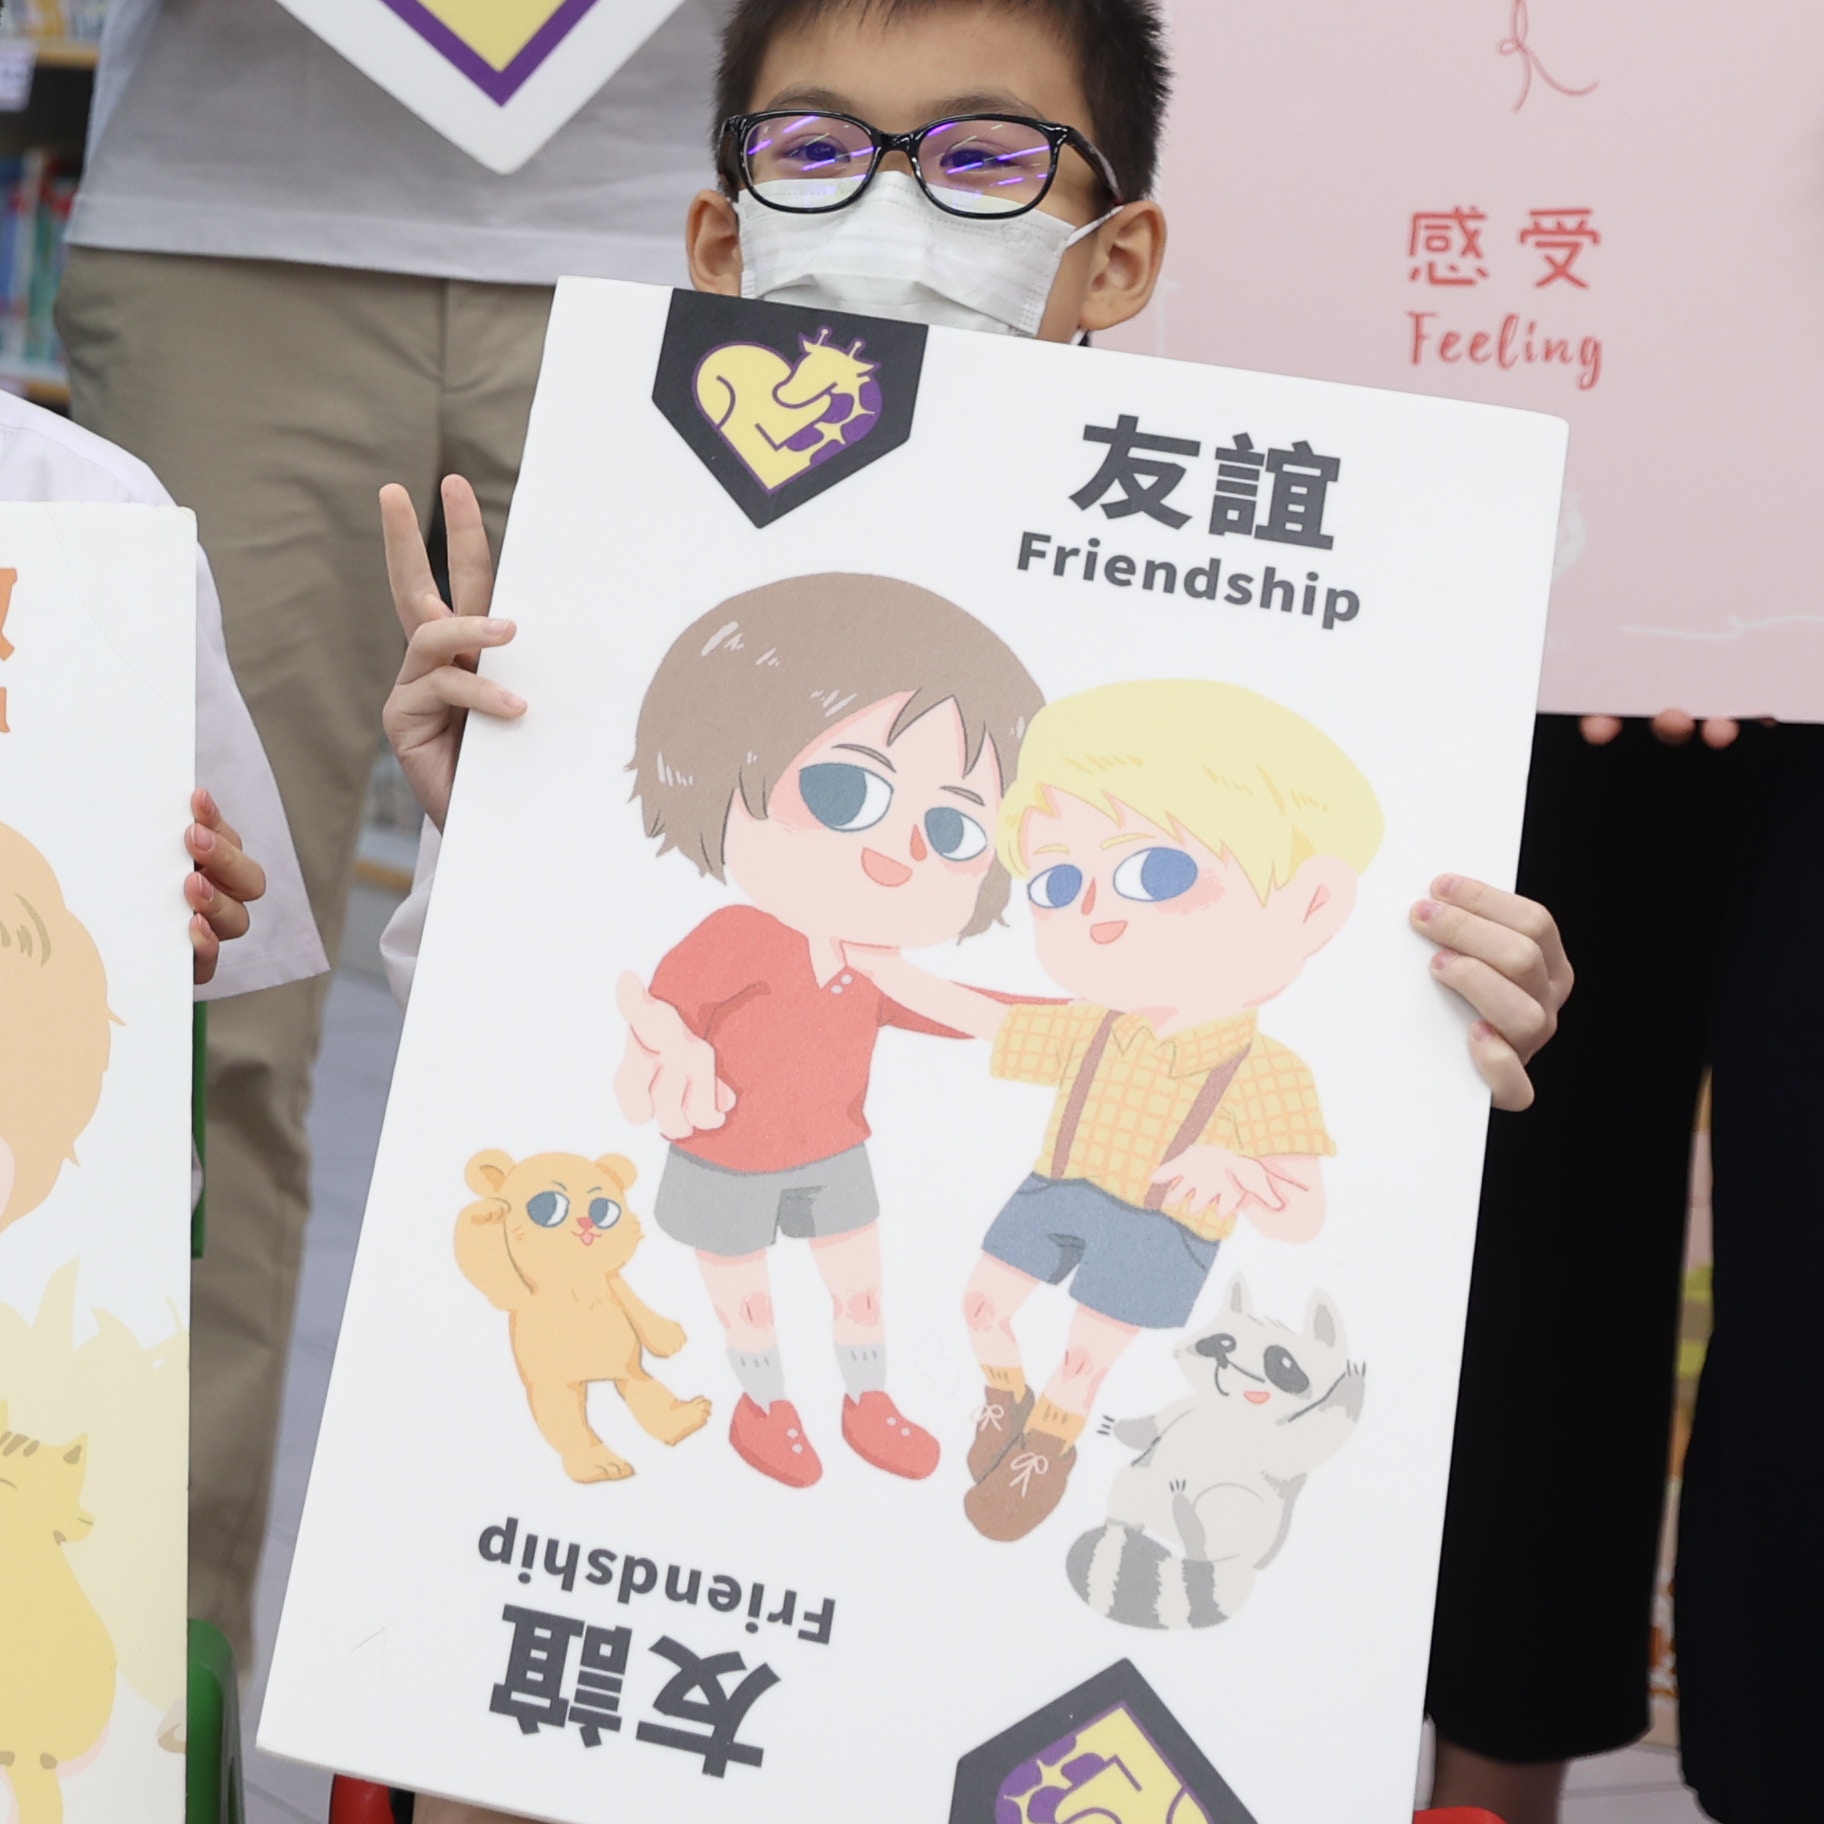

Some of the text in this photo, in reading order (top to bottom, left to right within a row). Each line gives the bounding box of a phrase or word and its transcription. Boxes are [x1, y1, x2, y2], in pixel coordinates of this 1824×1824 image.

[1408, 206, 1601, 290] 感受
[1408, 311, 1602, 391] Feeling
[1069, 413, 1341, 551] 友誼
[1017, 531, 1361, 630] Friendship
[478, 1516, 837, 1645] Friendship
[488, 1603, 782, 1780] 友誼
